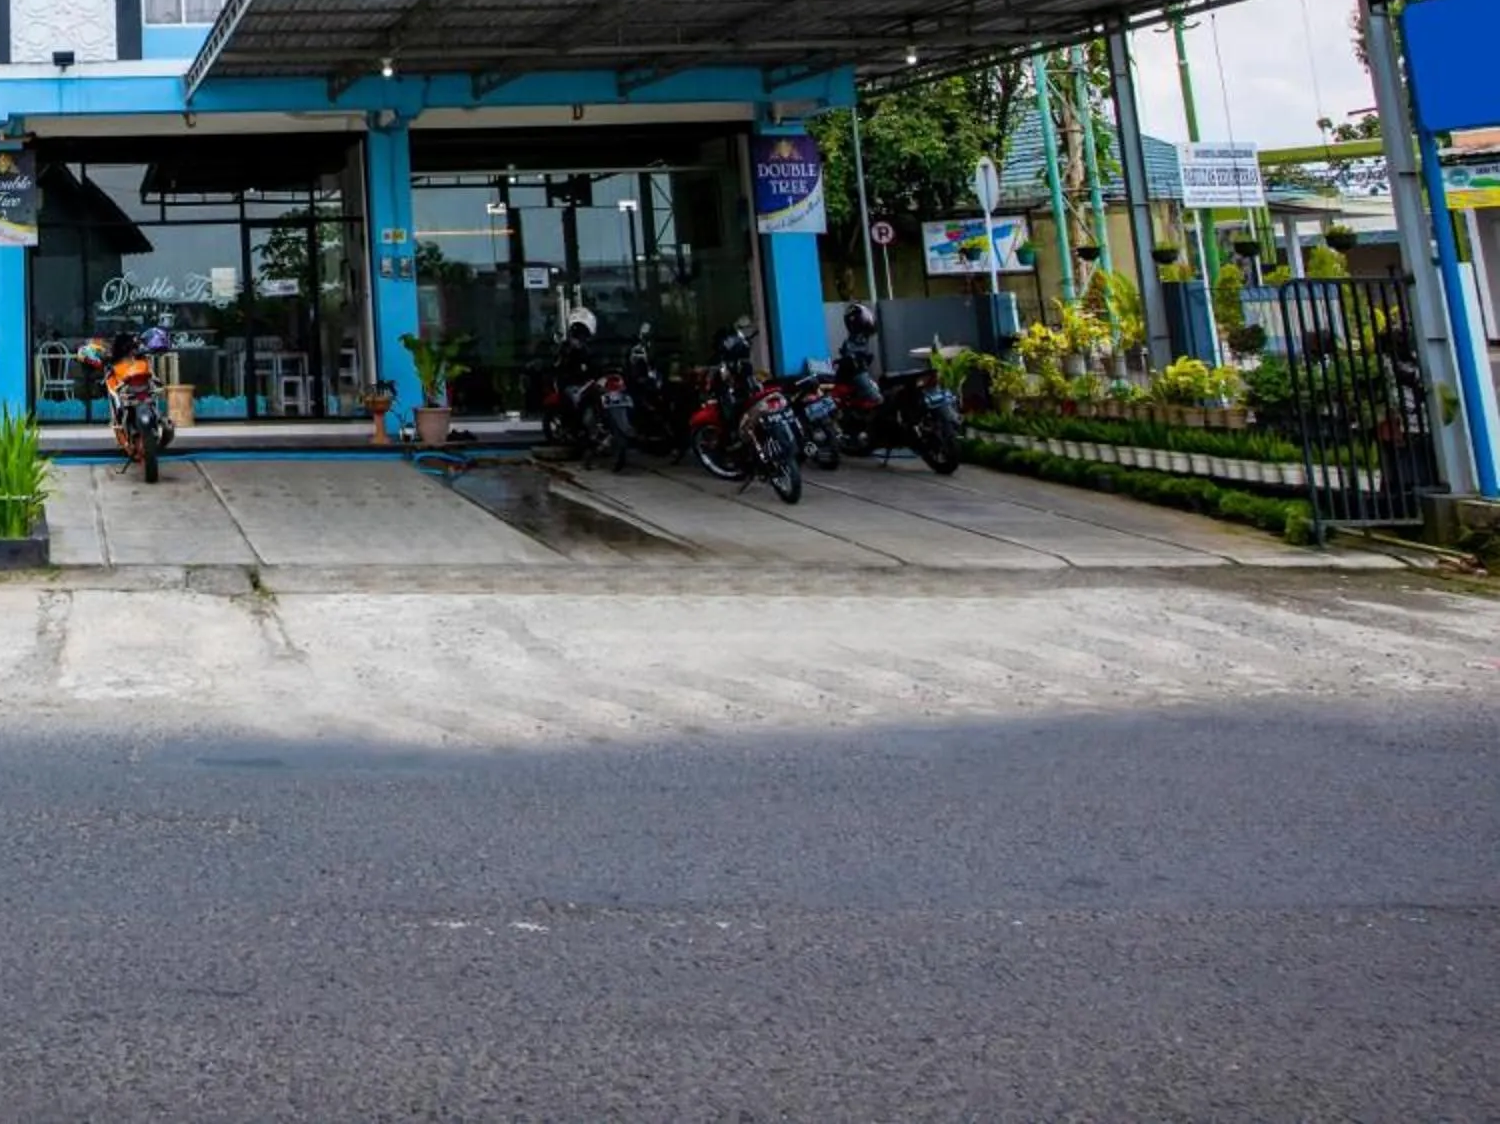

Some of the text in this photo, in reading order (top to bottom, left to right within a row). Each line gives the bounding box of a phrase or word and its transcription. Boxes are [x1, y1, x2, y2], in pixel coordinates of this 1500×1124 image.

[757, 163, 817, 177] DOUBLE
[769, 179, 809, 195] TREE
[100, 273, 175, 310] Double
